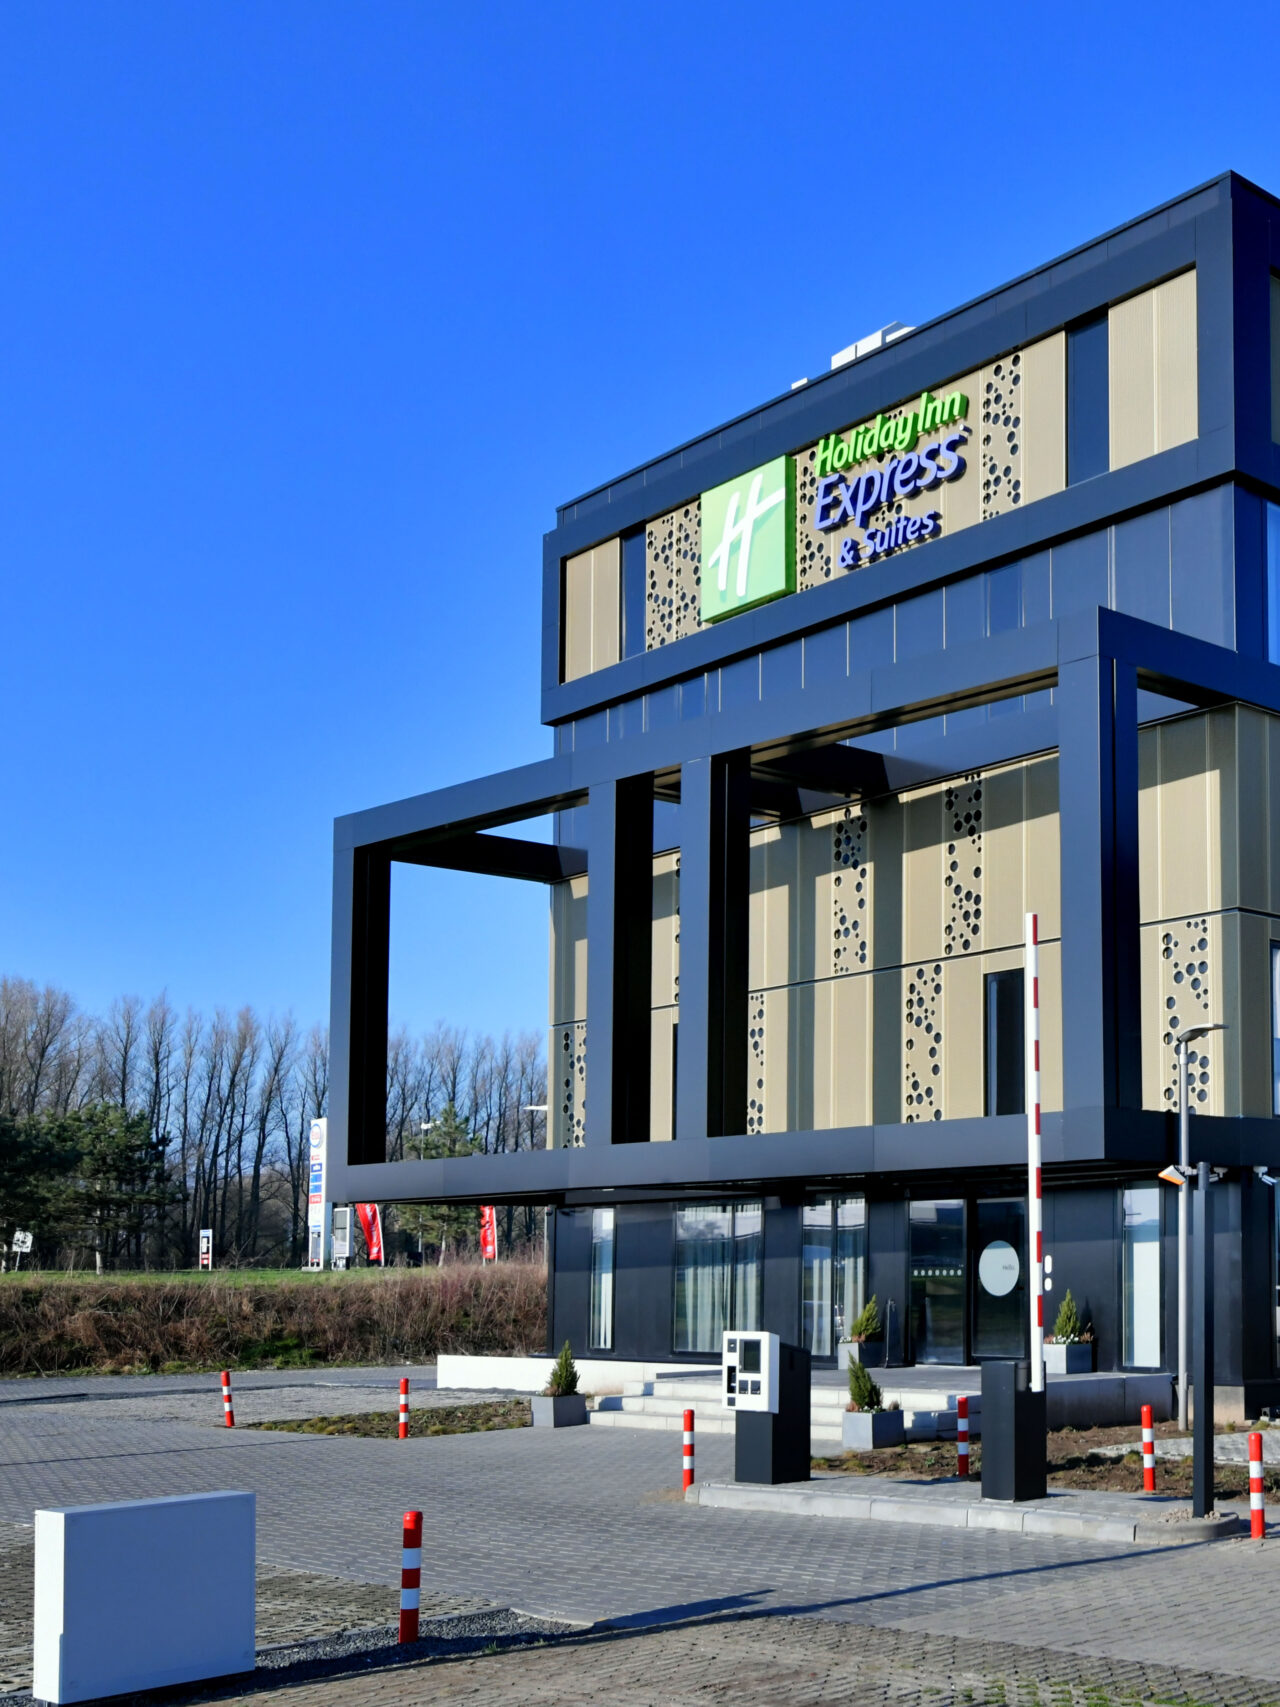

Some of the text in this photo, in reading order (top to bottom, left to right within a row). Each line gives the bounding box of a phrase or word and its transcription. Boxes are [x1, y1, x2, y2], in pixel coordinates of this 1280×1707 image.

[815, 391, 966, 476] Holiday Inn
[814, 433, 963, 531] Express
[837, 511, 939, 568] & Suites
